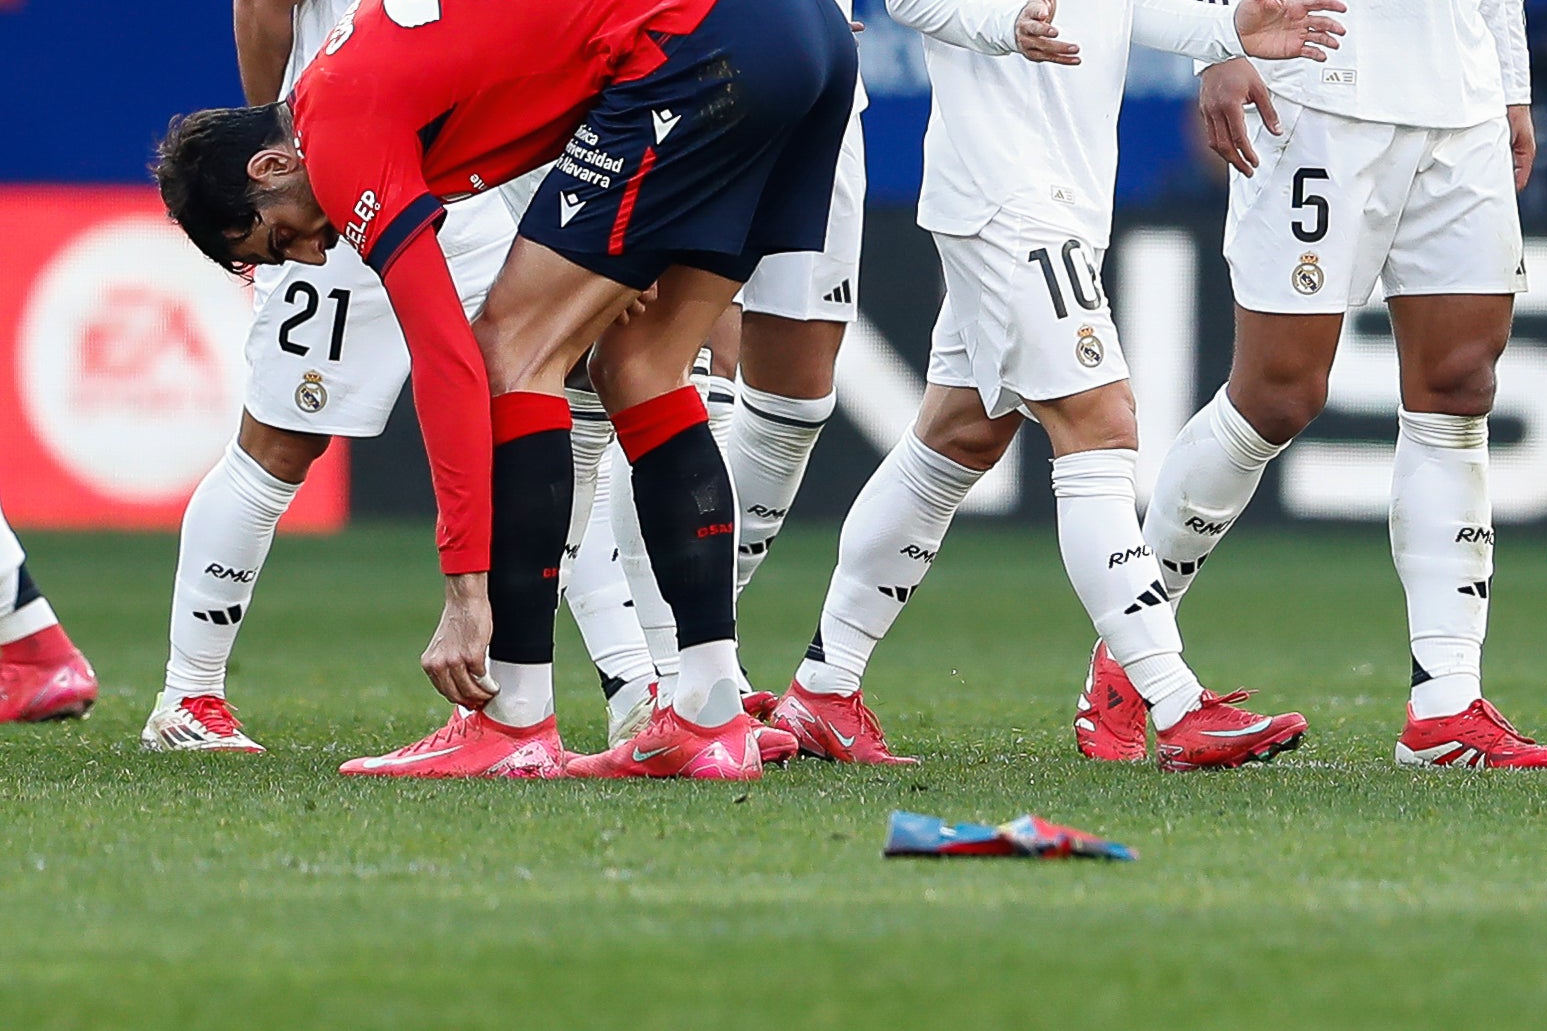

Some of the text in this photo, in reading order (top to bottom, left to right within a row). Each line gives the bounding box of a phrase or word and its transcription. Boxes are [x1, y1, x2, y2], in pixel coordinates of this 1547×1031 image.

[1291, 167, 1329, 243] 5
[1028, 239, 1102, 319] 10
[278, 280, 351, 362] 21
[748, 504, 787, 519] RM
[901, 544, 937, 565] RM
